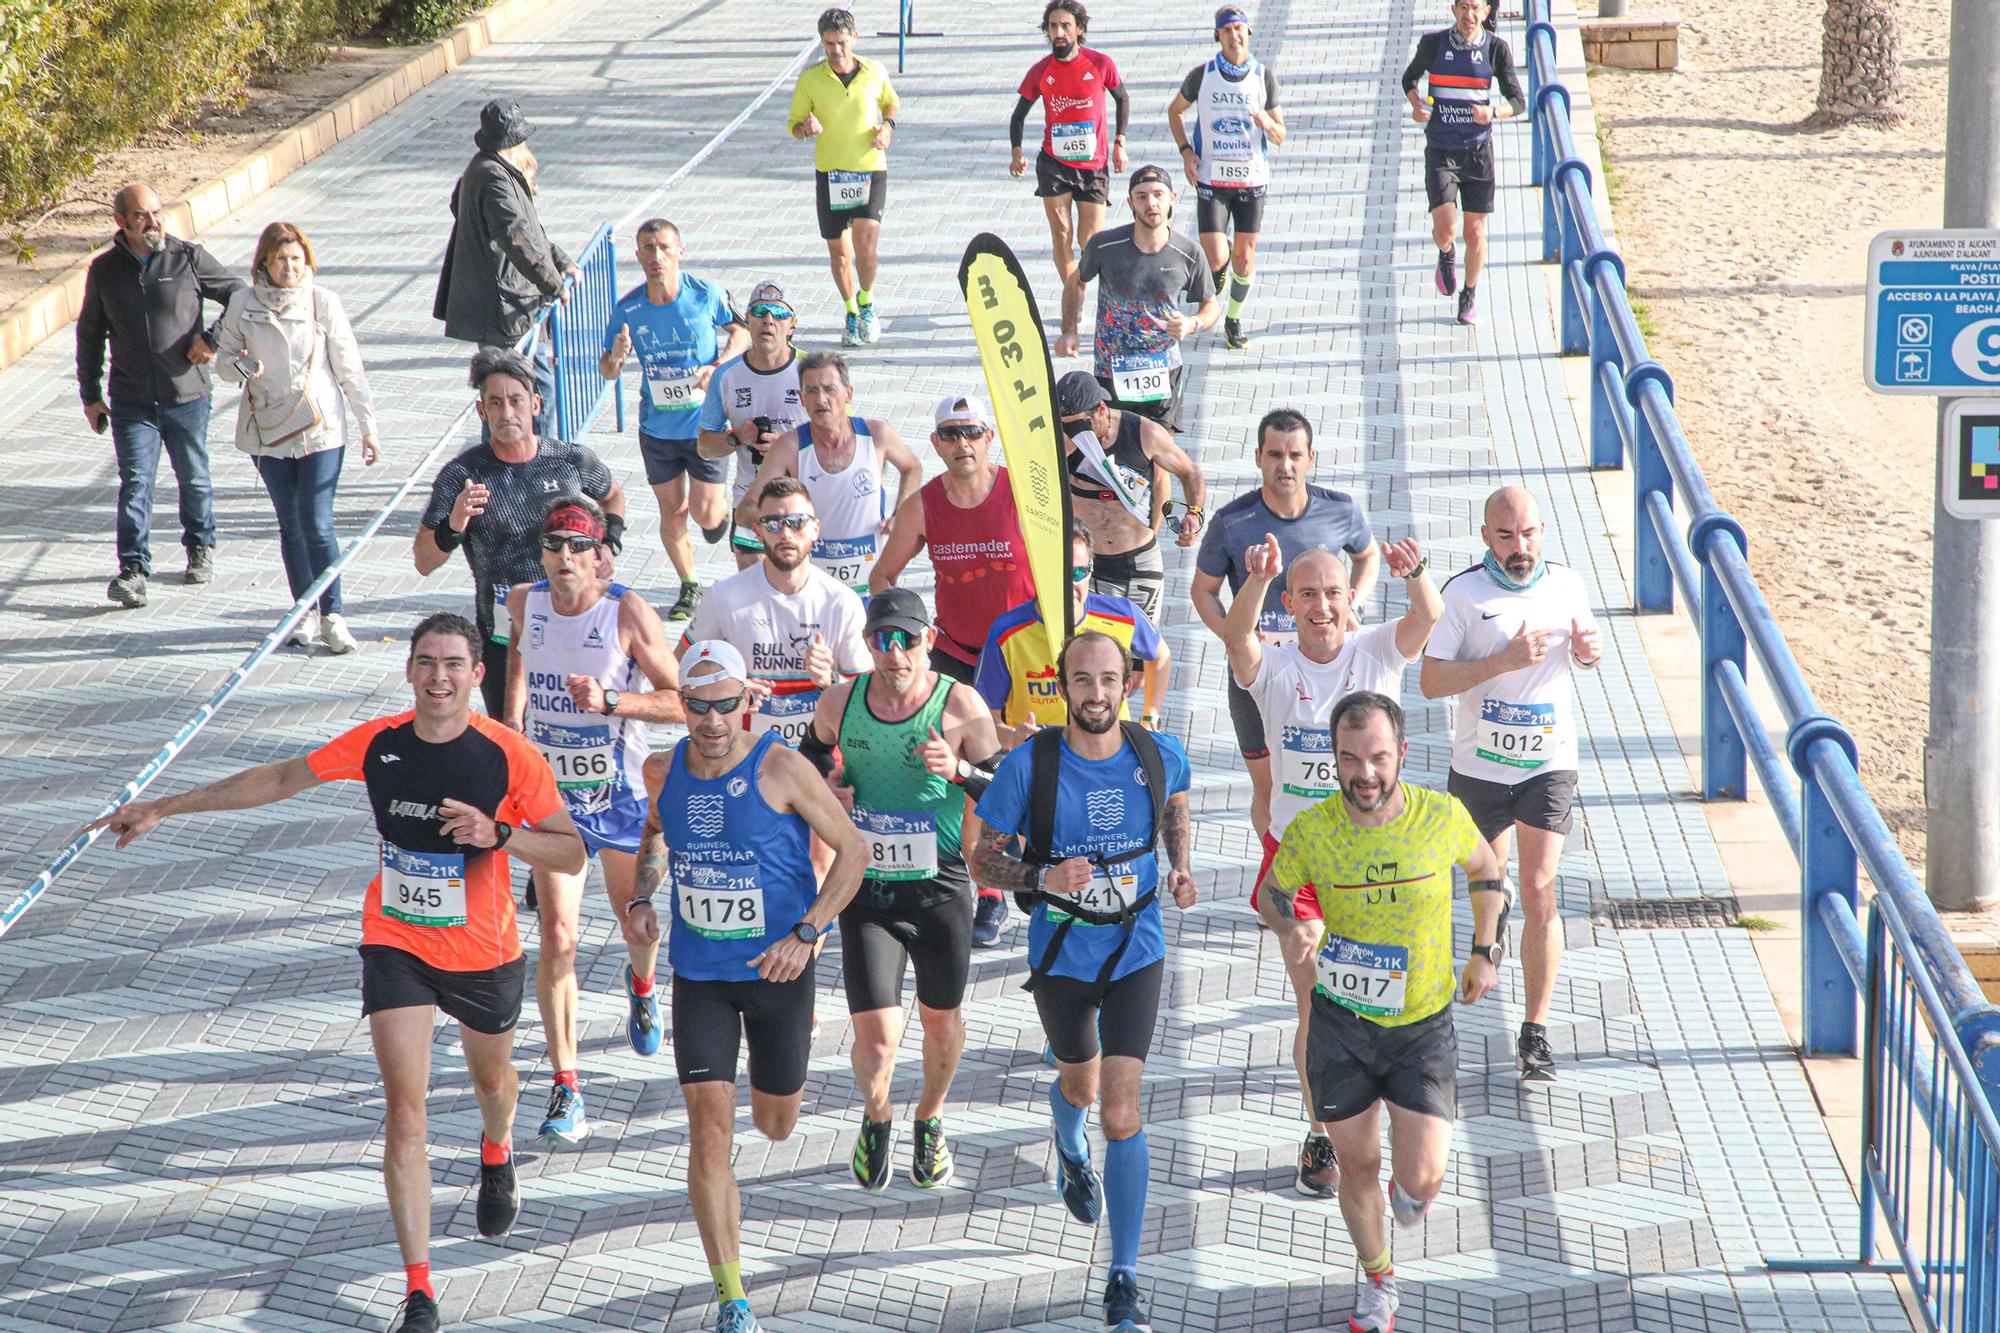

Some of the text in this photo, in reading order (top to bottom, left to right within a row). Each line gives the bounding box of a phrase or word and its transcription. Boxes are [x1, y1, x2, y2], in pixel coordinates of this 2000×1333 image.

[1212, 92, 1252, 104] SATSE
[1063, 139, 1087, 151] 465
[1219, 165, 1250, 178] 1853
[841, 187, 863, 199] 606
[1908, 240, 1997, 249] AYUNTAMIENTO DE ALICANTE
[1913, 250, 1991, 258] AJUNTAMENT D'ALACANT
[1951, 263, 1977, 271] PLAYA
[1887, 292, 1932, 301] ACCESO
[1934, 292, 1942, 301] A
[1944, 292, 1958, 301] LA
[1960, 292, 1995, 301] PLAYA
[1956, 304, 1993, 314] BEACH
[1124, 375, 1161, 390] 1130
[663, 384, 692, 399] 961
[852, 543, 872, 556] 21K
[933, 539, 1011, 554] castemader
[826, 563, 861, 581] 767
[752, 642, 785, 656] BULL
[581, 737, 607, 748] 21K
[1491, 731, 1543, 752] 1012
[904, 820, 931, 833] 21K
[1087, 833, 1128, 843] RUNNERS
[687, 841, 731, 850] RUNNERS
[872, 842, 912, 862] 811
[1066, 838, 1144, 854] MONTEMAR
[429, 866, 459, 878] 21K
[728, 876, 756, 890] 21K
[399, 883, 442, 908] 945
[1069, 887, 1112, 908] 941
[686, 895, 756, 924] 1178
[1374, 956, 1402, 970] 21K
[1328, 971, 1391, 998] 1017
